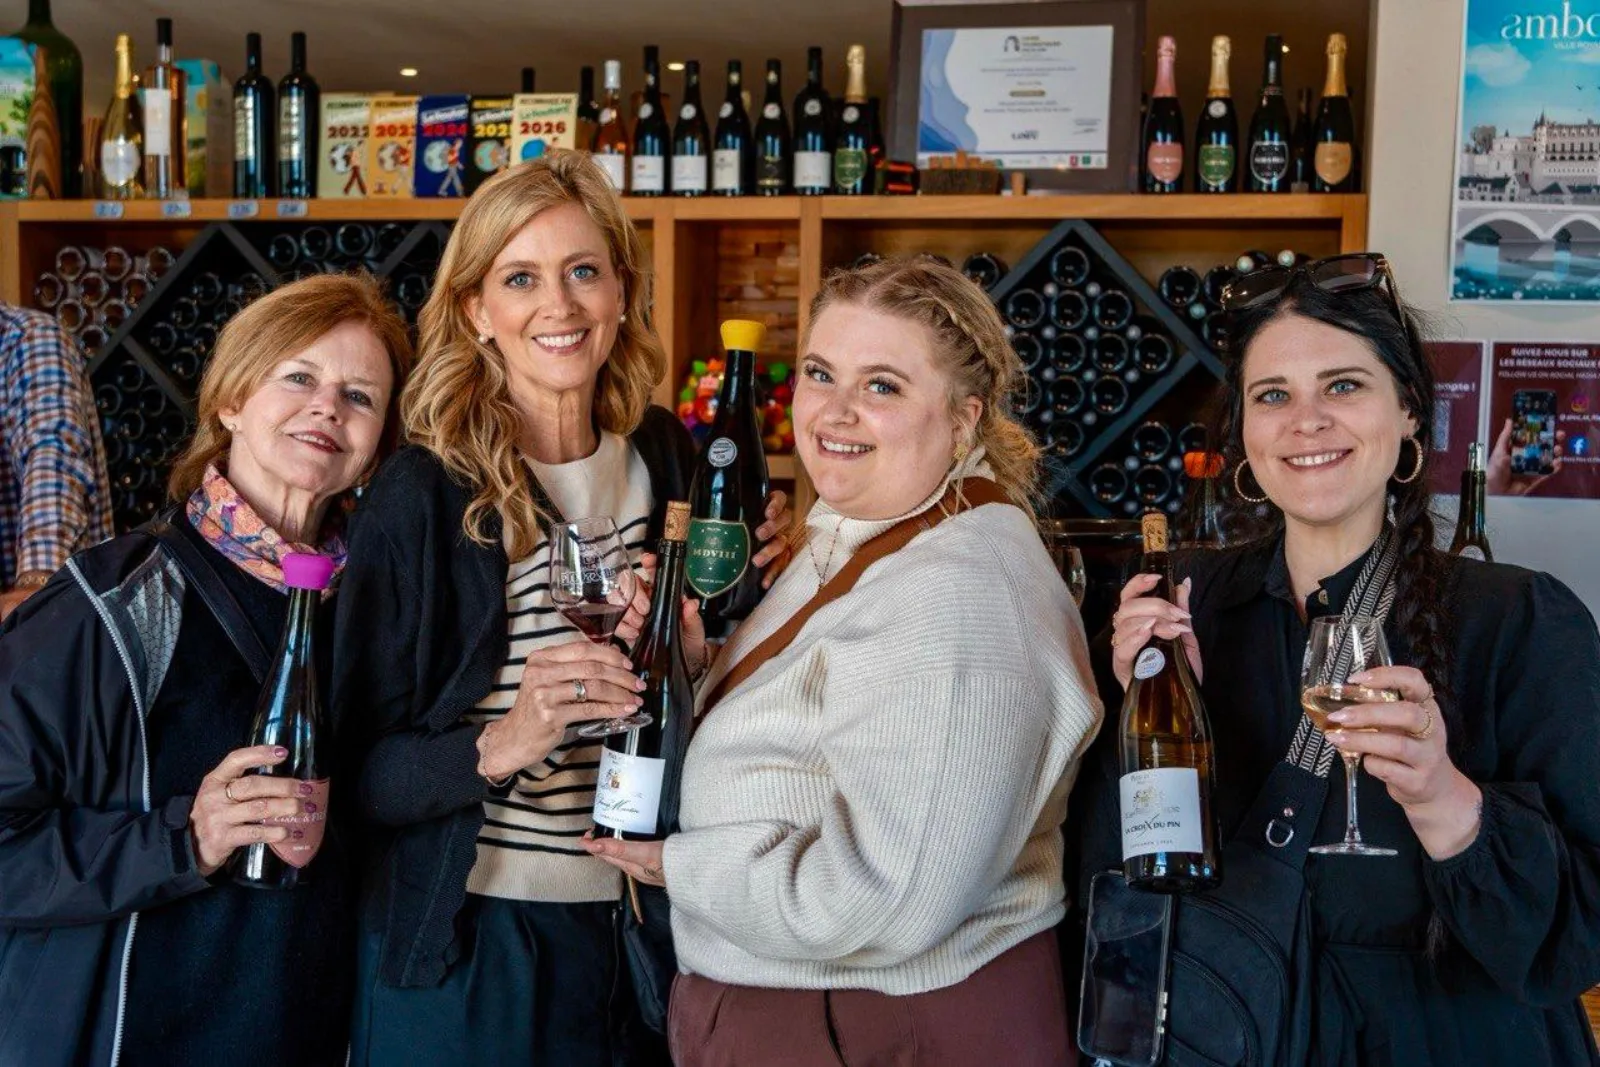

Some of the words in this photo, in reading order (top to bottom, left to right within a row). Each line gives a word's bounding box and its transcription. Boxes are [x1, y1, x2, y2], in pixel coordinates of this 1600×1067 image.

[376, 124, 417, 138] 202
[423, 123, 468, 137] 2024
[474, 123, 510, 137] 202
[520, 121, 566, 134] 2026
[1511, 347, 1569, 357] SUIVEZ-NOUS
[1571, 348, 1588, 357] SUR
[1500, 358, 1514, 367] LES
[1557, 359, 1596, 368] SOCIAUX
[1153, 820, 1165, 829] DU
[1167, 820, 1181, 829] PIN
